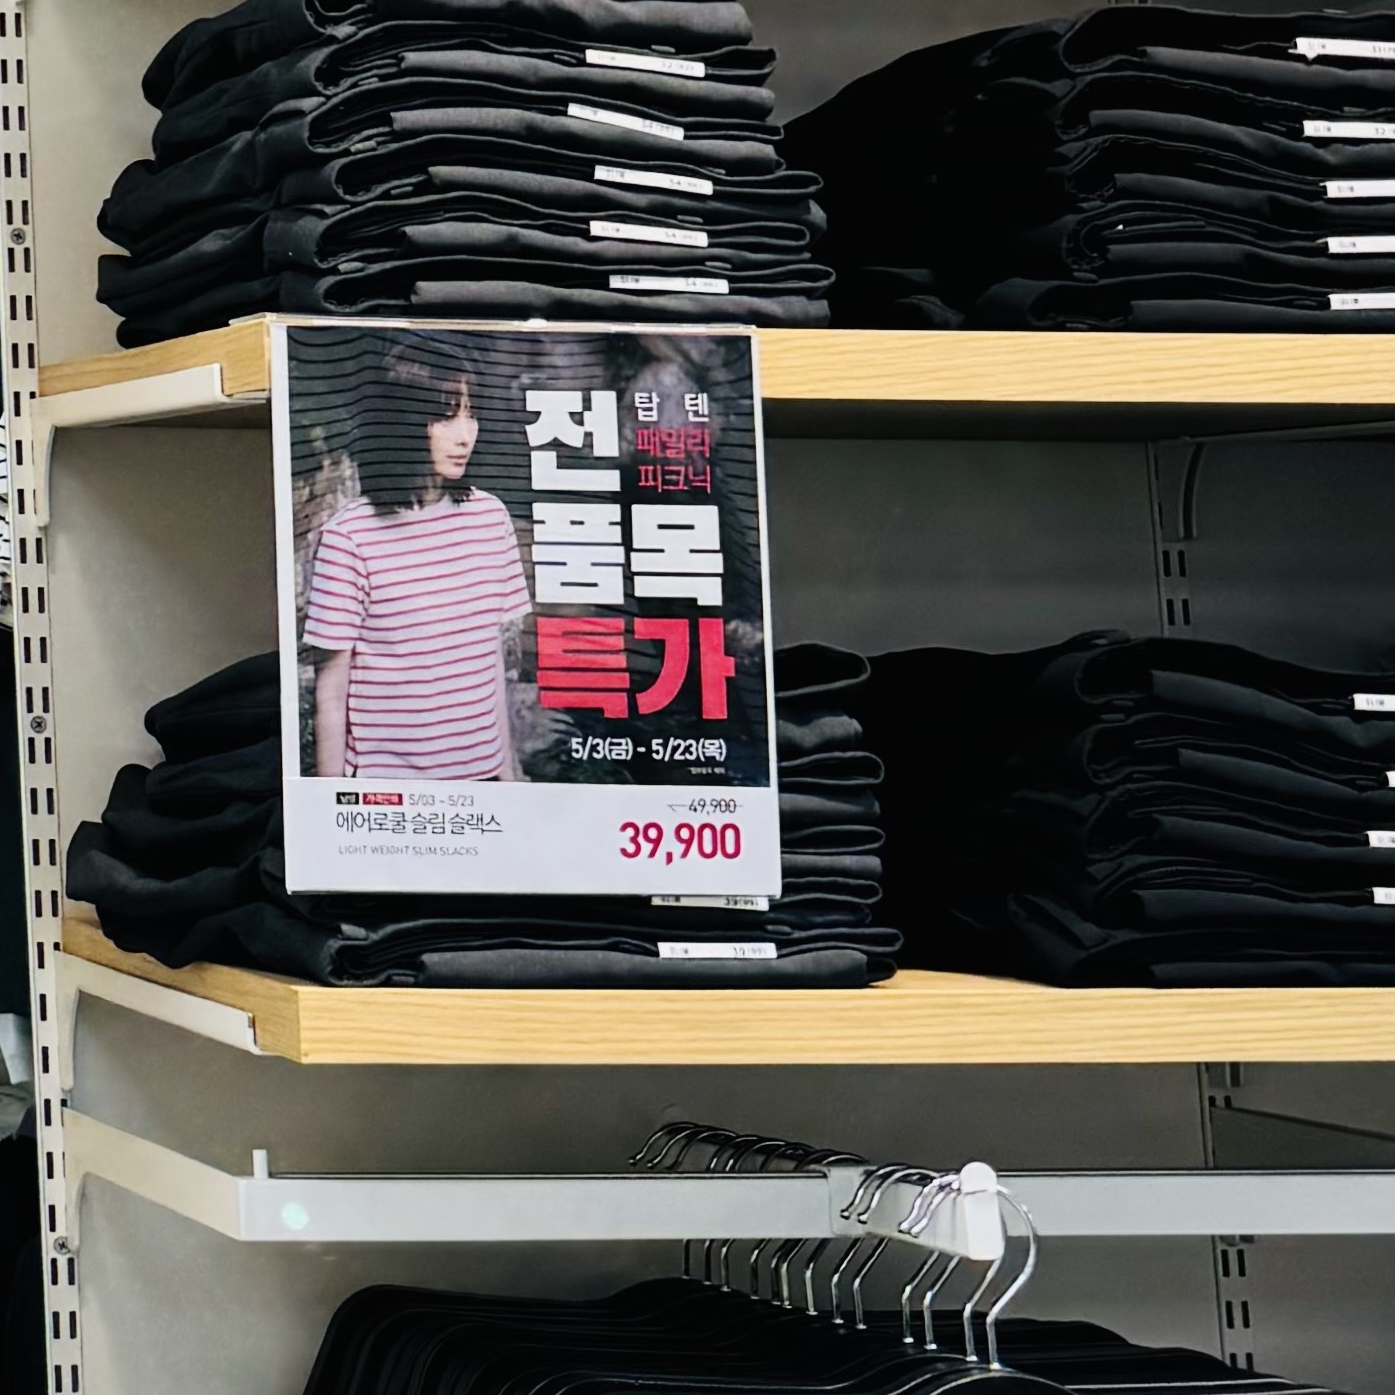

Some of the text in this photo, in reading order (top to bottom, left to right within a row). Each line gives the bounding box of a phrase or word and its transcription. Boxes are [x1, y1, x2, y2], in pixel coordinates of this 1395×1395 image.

[525, 390, 621, 492] 전
[636, 428, 710, 459] 패밀리
[639, 465, 710, 494] 피크닉
[532, 503, 724, 607] 품목
[536, 617, 736, 719] 특가
[570, 736, 633, 761] 5/3(금)
[651, 736, 727, 762] 5/23(목)
[448, 794, 475, 807] 5/23
[688, 798, 737, 815] 49,900
[336, 811, 407, 834] 에어로쿨
[410, 812, 446, 835] 슬림
[338, 845, 480, 856] LIGHT WEIGHT SLIM SLACKS
[619, 821, 741, 866] 39,900
